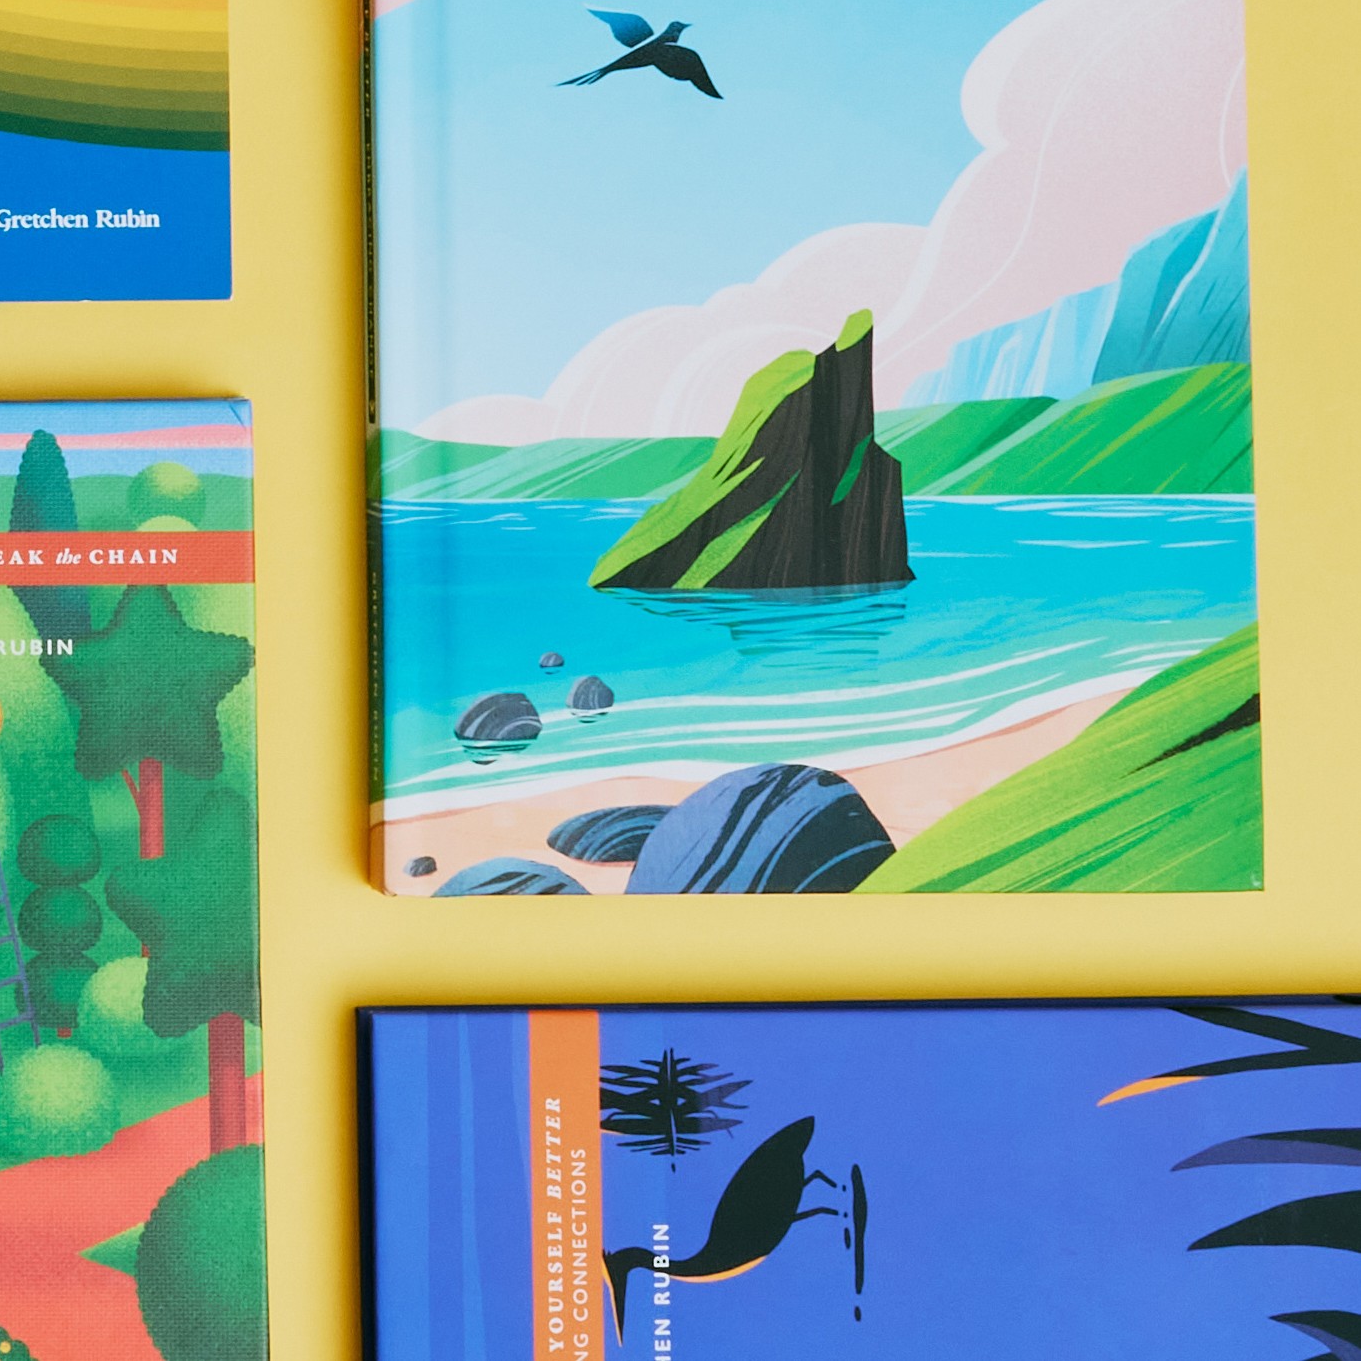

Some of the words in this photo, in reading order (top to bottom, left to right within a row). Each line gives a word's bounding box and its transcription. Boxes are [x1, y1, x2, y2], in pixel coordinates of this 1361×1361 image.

[96, 209, 160, 228] Rubin
[56, 548, 81, 564] the
[89, 549, 177, 564] CHAIN
[545, 1098, 561, 1199] BETTER
[571, 1149, 588, 1321] CONNECTIONS
[653, 1224, 671, 1306] RUBIN
[547, 1212, 564, 1352] YOURSELF
